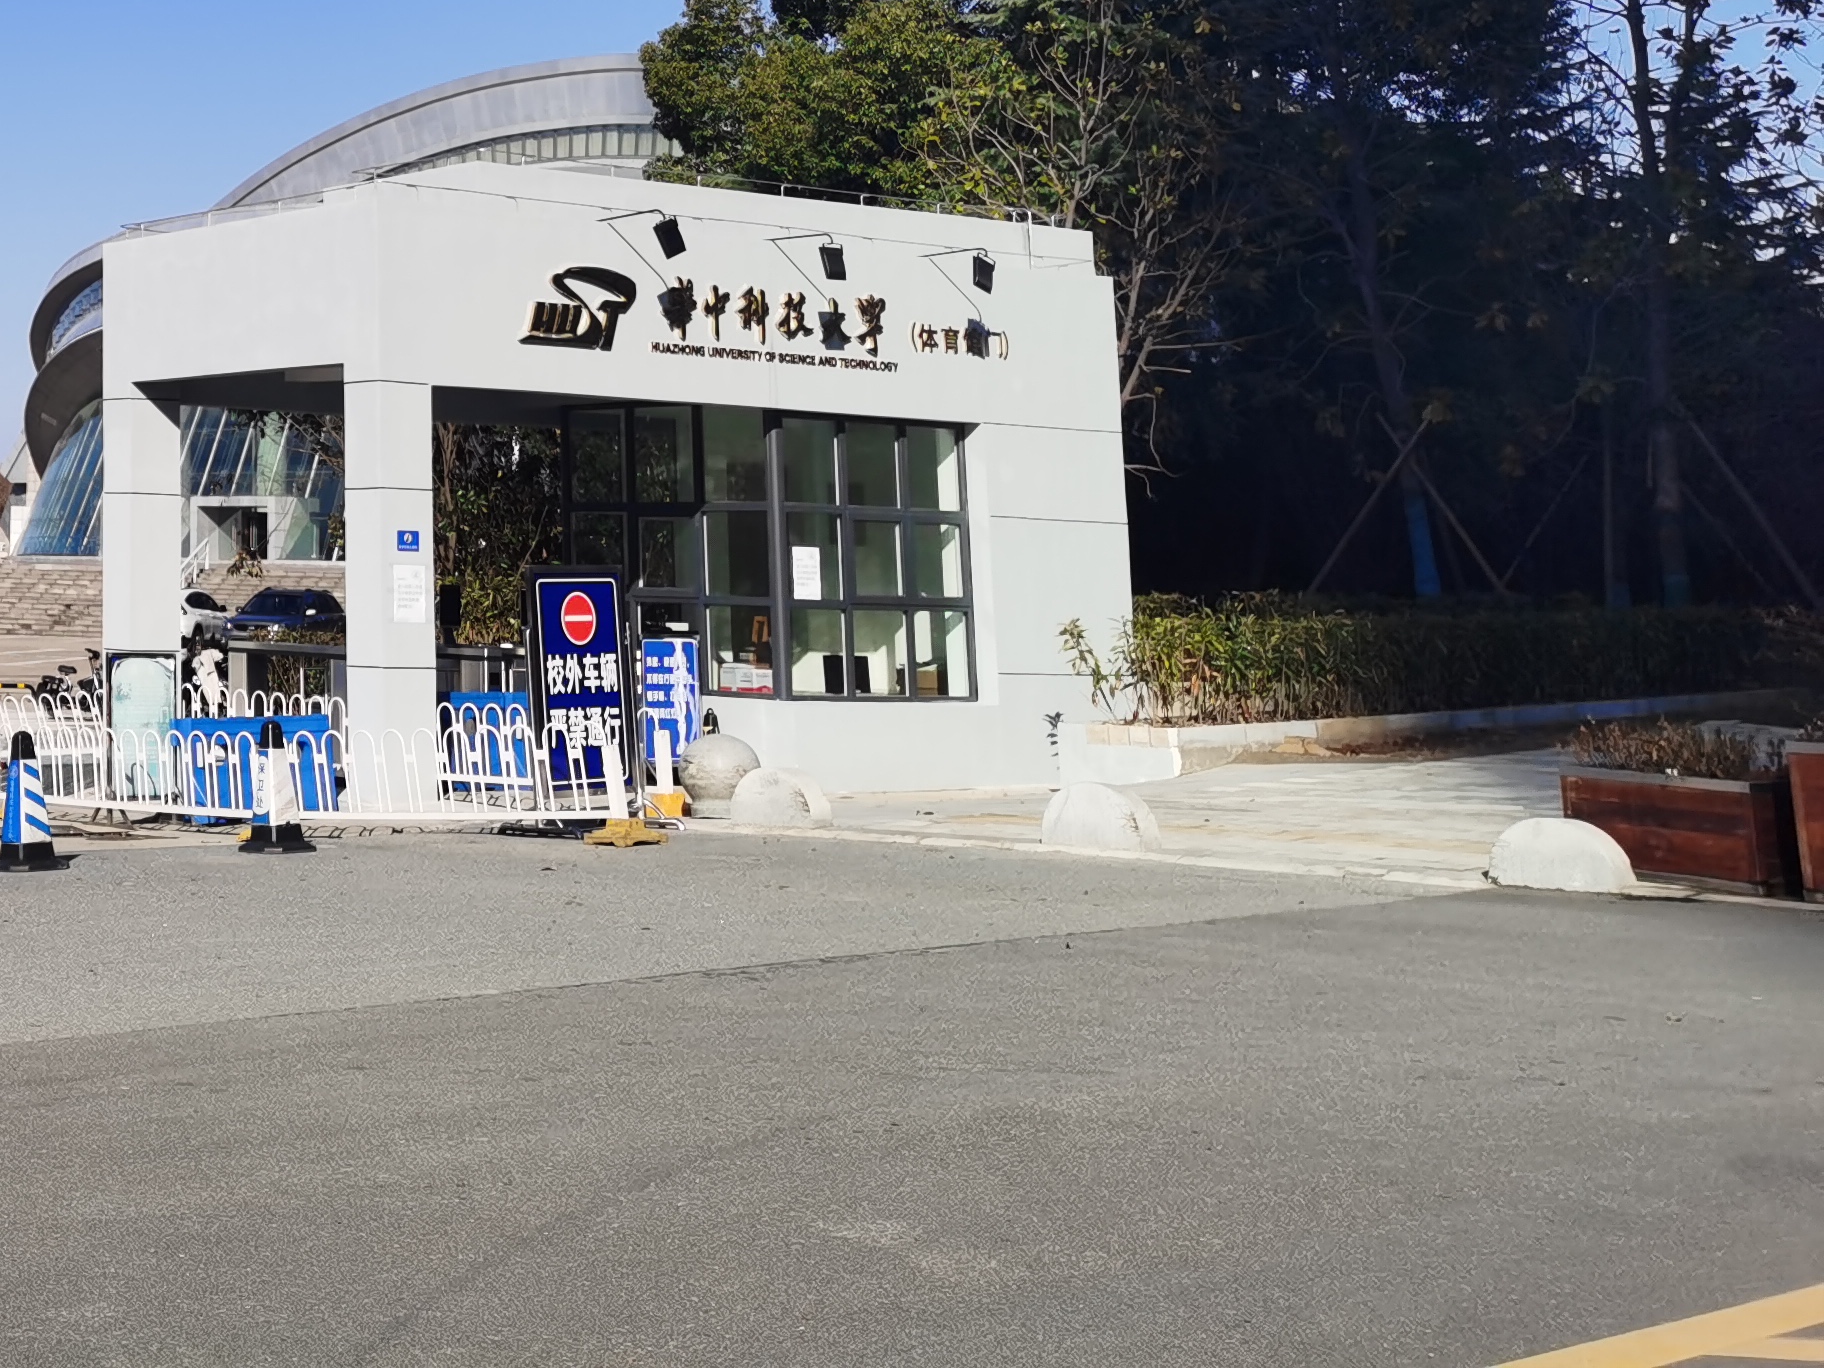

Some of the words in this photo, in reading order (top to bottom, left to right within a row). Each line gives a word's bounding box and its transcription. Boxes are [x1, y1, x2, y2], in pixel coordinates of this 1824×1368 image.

[651, 341, 705, 357] HUAZHONG
[707, 346, 763, 363] UNIVERSITY
[764, 351, 776, 363] OF
[778, 353, 817, 366] SCIENCE
[818, 356, 838, 368] AND
[839, 357, 899, 373] TECHNOLOGY
[546, 652, 620, 695] 校外车辆
[549, 705, 622, 749] 严禁通行
